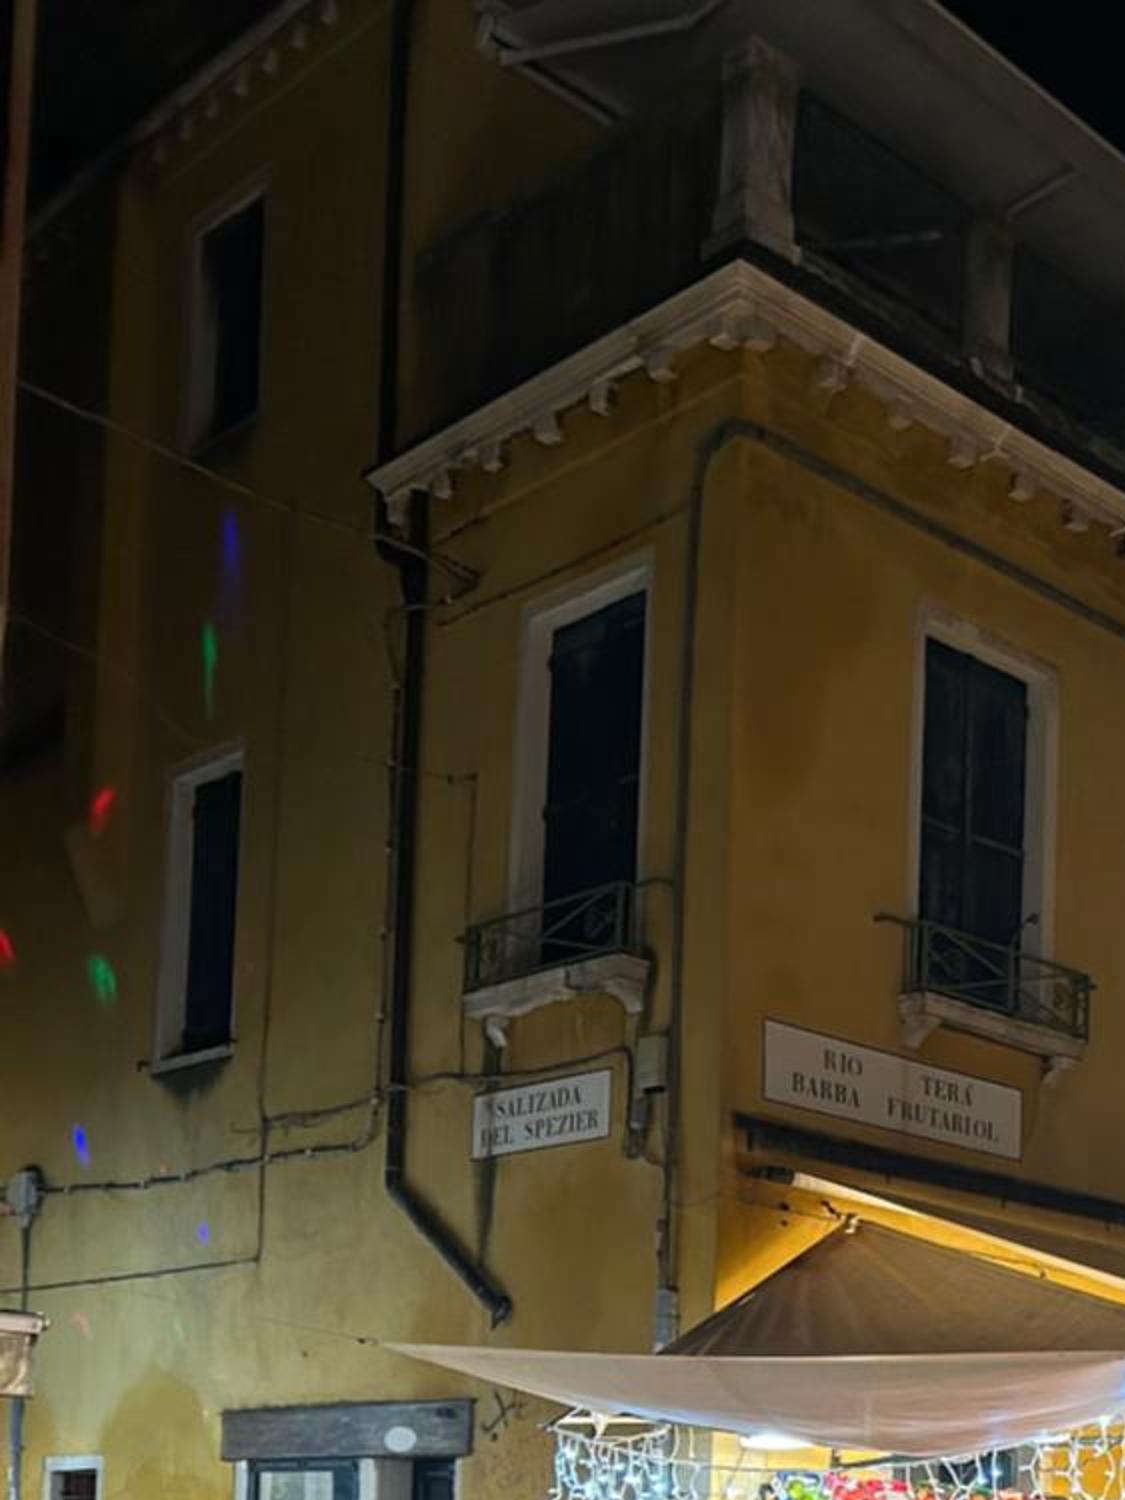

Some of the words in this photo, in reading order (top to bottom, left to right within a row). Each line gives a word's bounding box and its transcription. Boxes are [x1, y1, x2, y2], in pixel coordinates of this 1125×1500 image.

[823, 1048, 863, 1076] RIO
[495, 1086, 583, 1118] SALIZADA
[791, 1071, 860, 1109] BARBA
[887, 1096, 999, 1143] FRUTARIOL
[480, 1124, 514, 1149] DEL
[524, 1108, 599, 1139] SPEZIER
